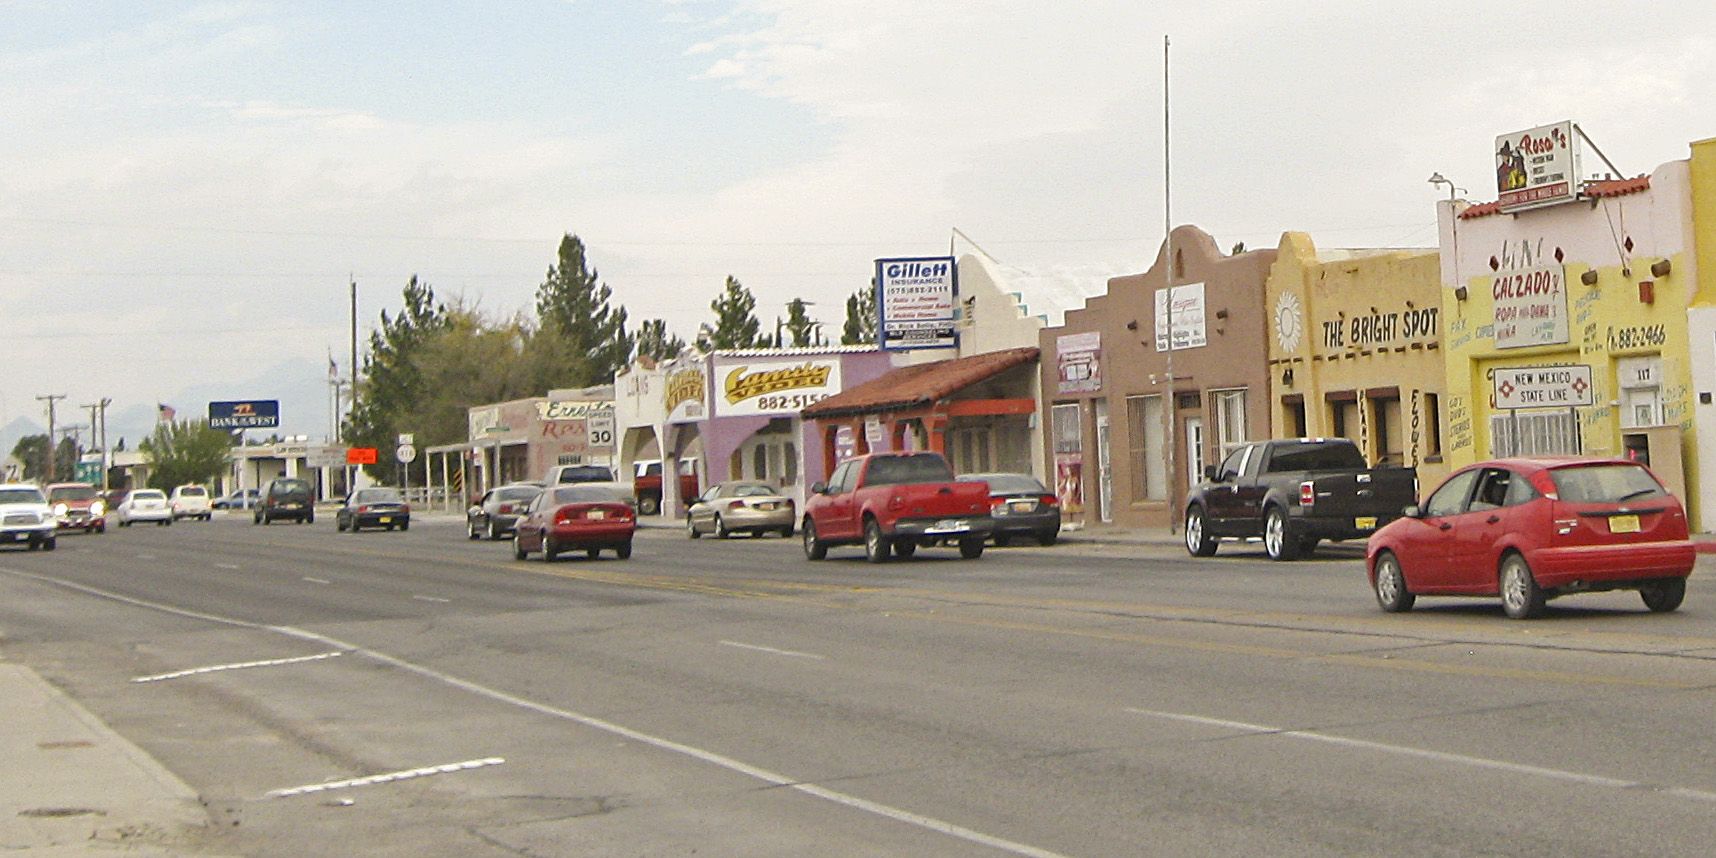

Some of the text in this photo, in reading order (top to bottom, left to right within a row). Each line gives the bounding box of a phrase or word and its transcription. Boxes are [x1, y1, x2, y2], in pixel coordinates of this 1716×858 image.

[887, 263, 947, 278] Gillett
[1493, 270, 1550, 300] CALZADO
[1496, 307, 1517, 322] ROPA
[1530, 304, 1549, 319] DAMA
[1323, 307, 1438, 347] THE BRIGHT SPOT
[1515, 374, 1534, 385] NEW
[1538, 371, 1571, 384] MEXICO
[1637, 369, 1650, 380] 117
[1520, 389, 1568, 402] STATE LINE
[211, 417, 239, 427] BANK
[248, 416, 276, 426] WEST
[591, 430, 611, 443] 30
